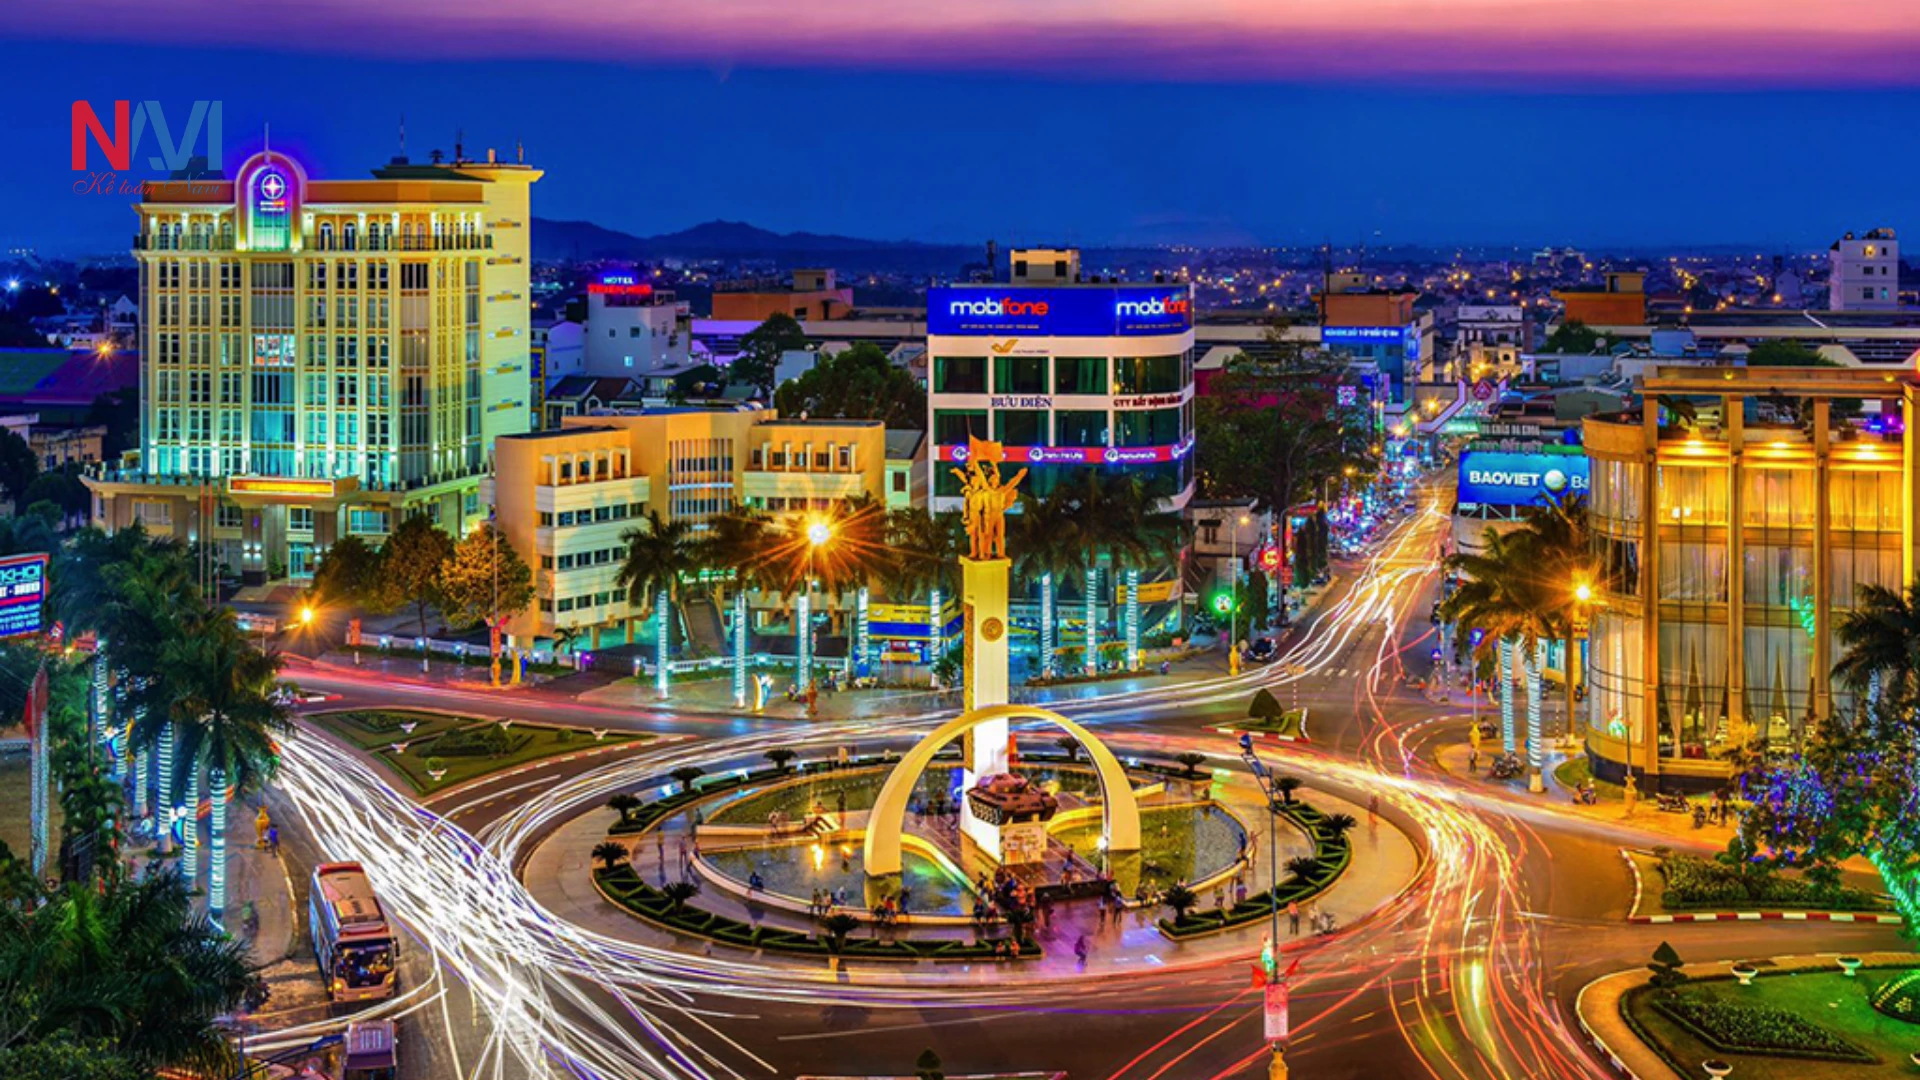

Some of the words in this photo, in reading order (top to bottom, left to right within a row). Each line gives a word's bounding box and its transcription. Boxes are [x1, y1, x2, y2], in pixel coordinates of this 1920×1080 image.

[950, 297, 1049, 316] mobifone
[1469, 470, 1541, 486] BAOVIET
[0, 565, 40, 583] KHOI
